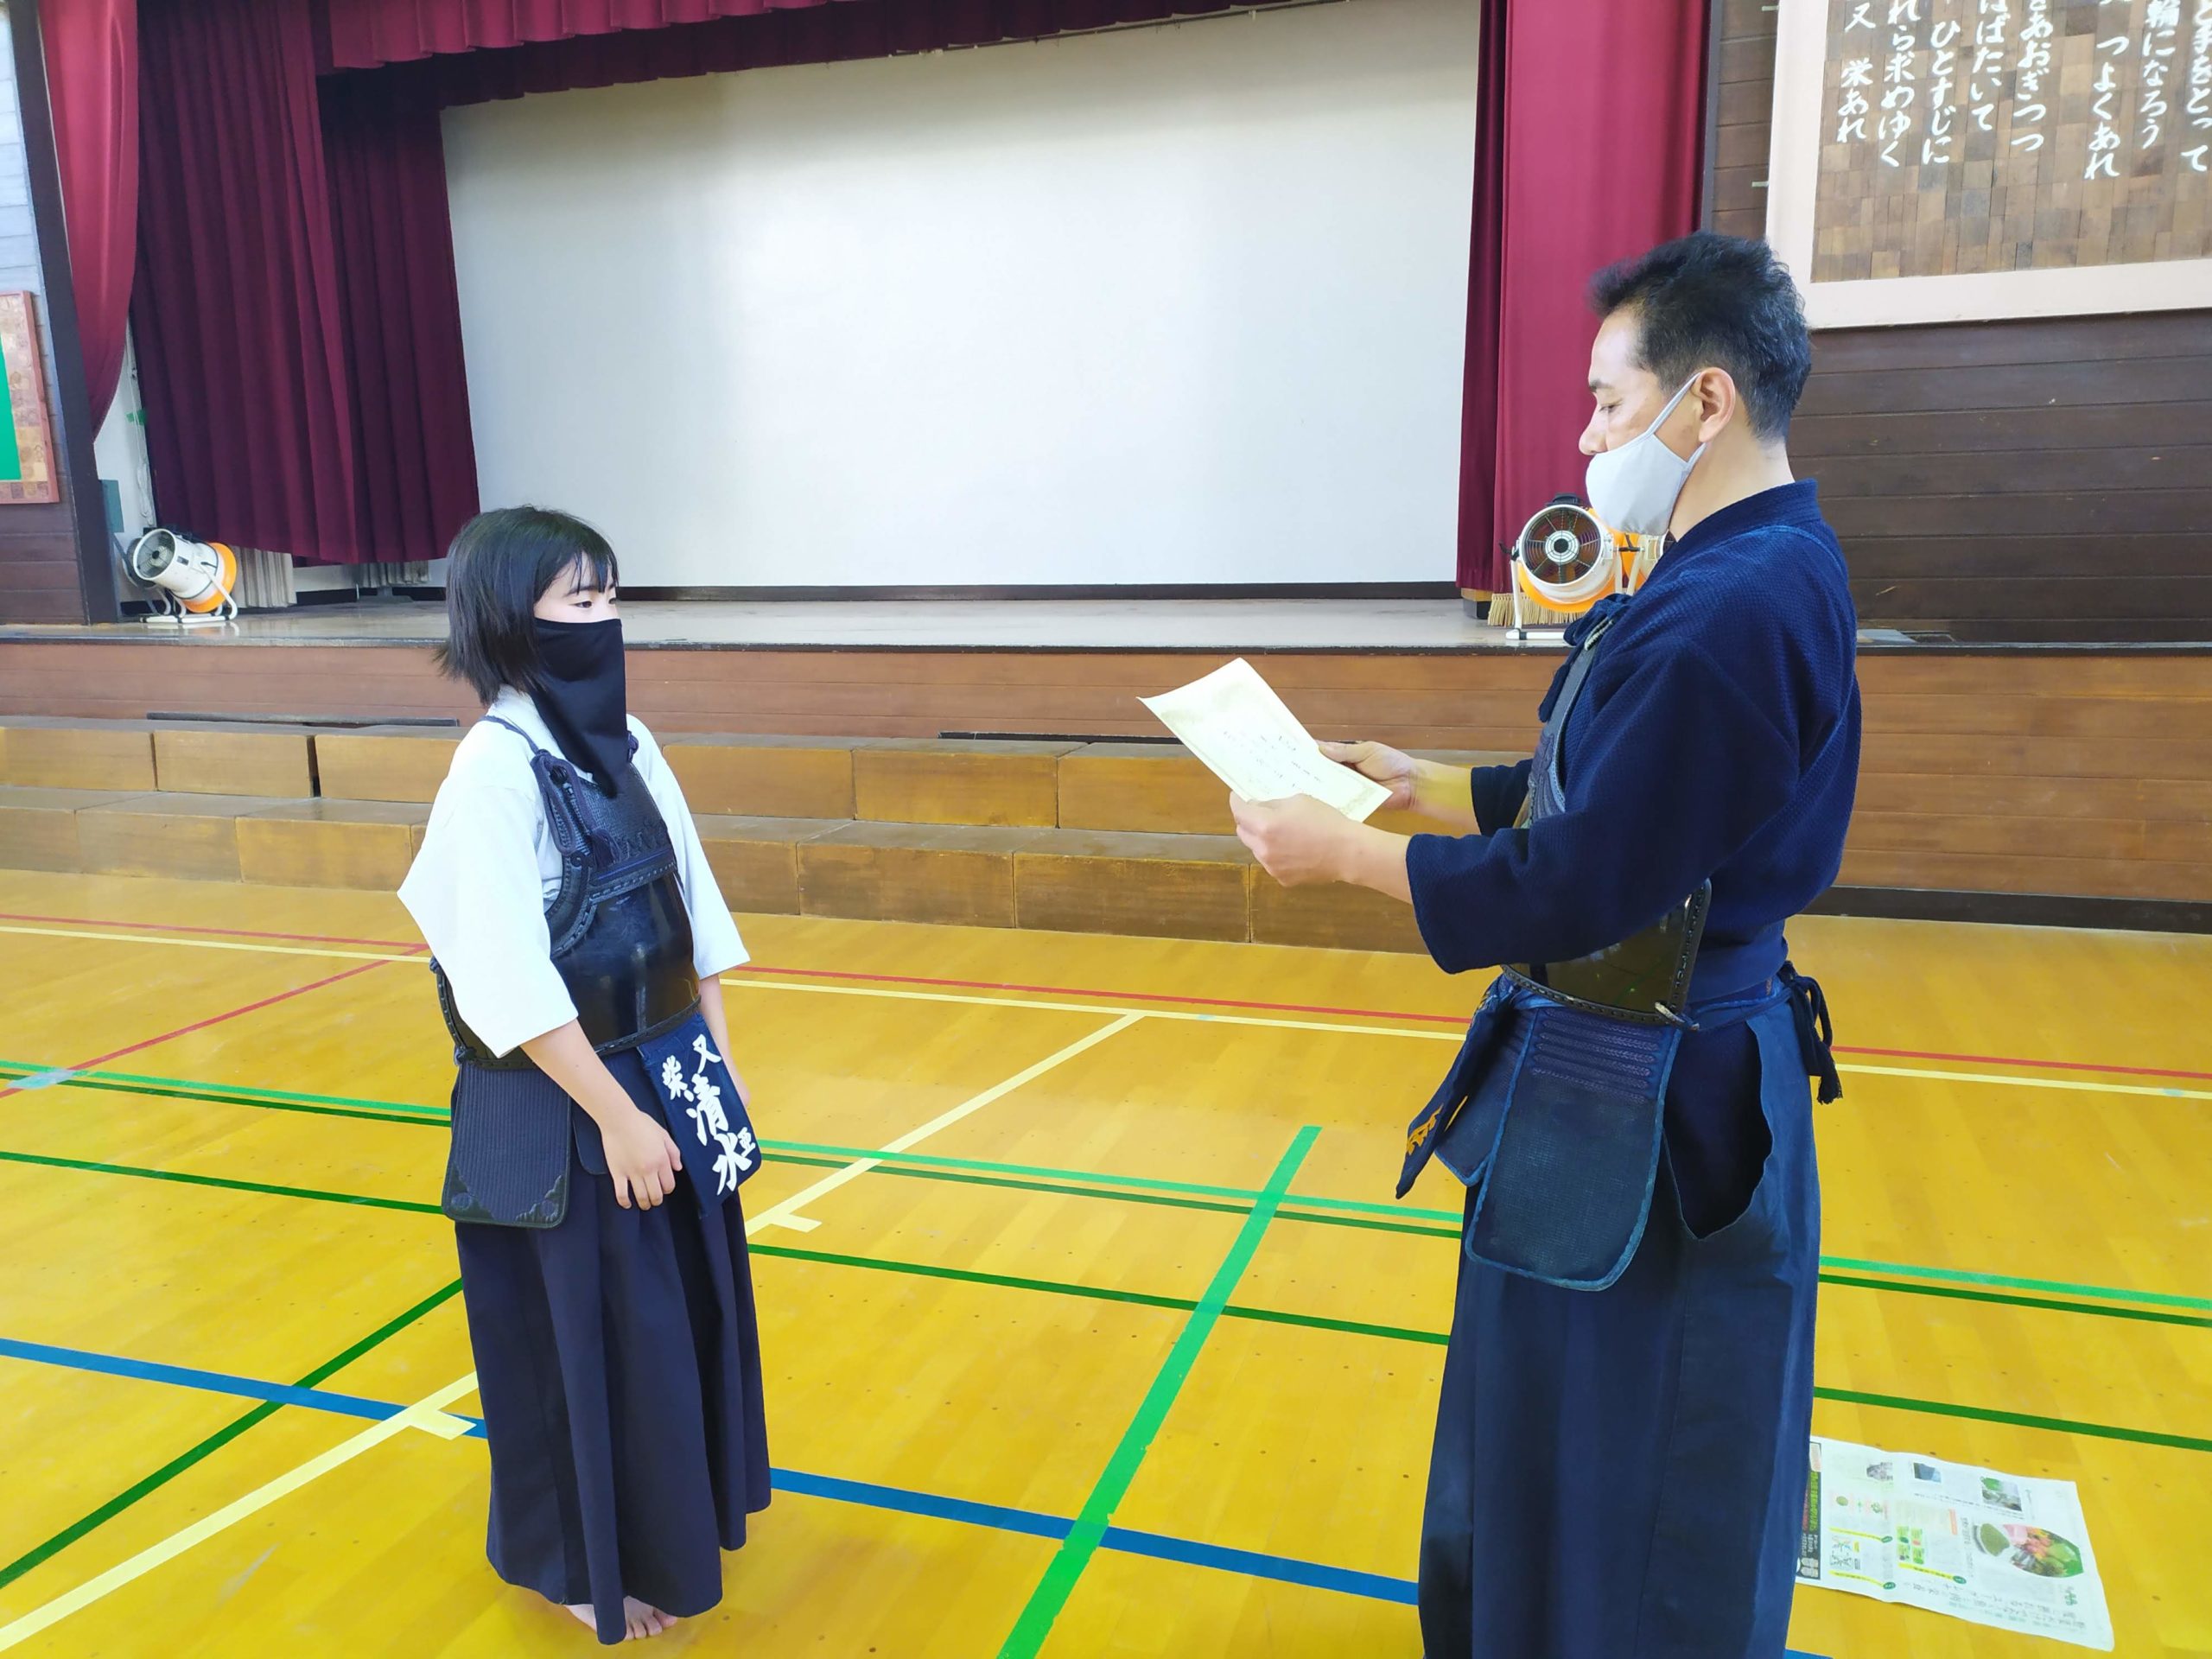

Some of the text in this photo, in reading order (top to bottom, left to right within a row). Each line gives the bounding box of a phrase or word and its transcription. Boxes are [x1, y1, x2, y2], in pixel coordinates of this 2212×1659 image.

[1836, 2, 1877, 143] 又 栄あれ
[1878, 0, 1922, 168] れら求めゆく
[1922, 20, 1961, 165] ひとすじに
[2083, 35, 2130, 180] つよくあれ
[685, 1072, 753, 1196] 清水
